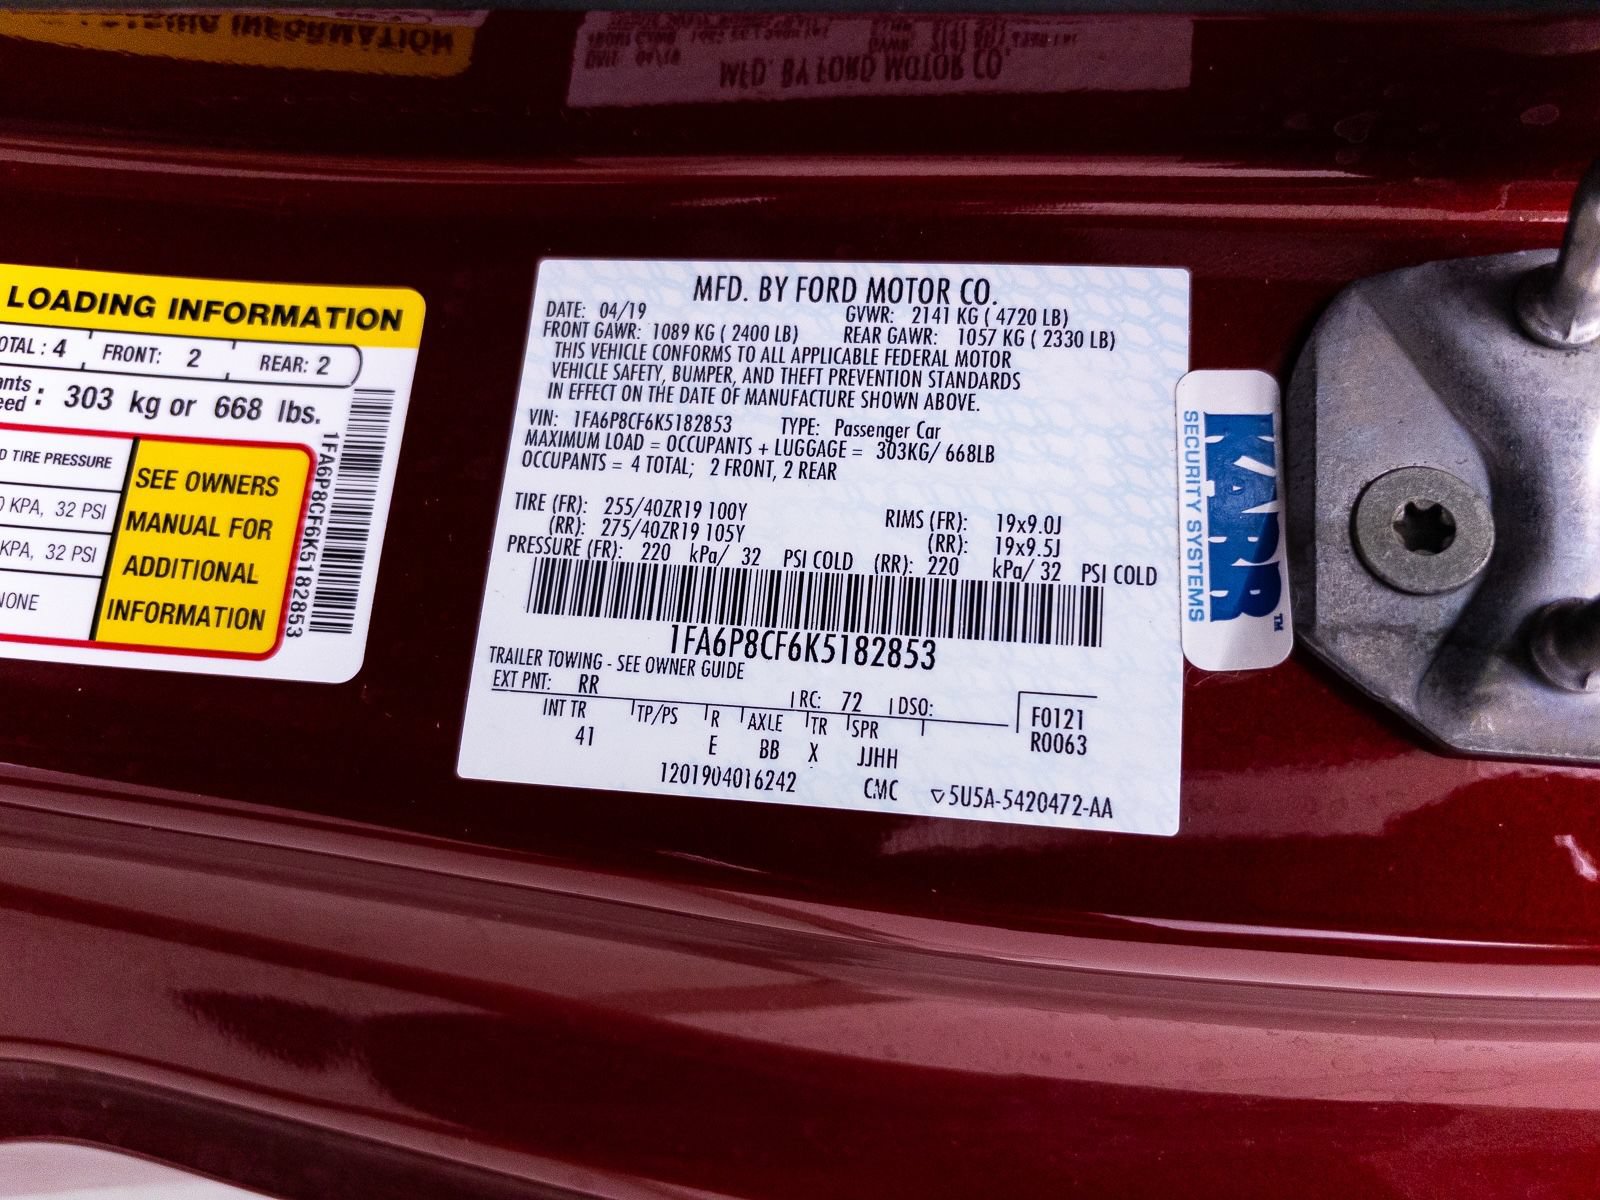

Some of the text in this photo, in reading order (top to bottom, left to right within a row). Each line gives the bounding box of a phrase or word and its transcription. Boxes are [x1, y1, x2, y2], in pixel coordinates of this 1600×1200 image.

[693, 275, 997, 305] MFD. BY FORD MOTOR CO.
[7, 285, 403, 331] LOADING INFORMATION
[546, 300, 647, 321] DATE: 04/19
[846, 305, 894, 323] GVWR:
[912, 306, 949, 324] 2141
[957, 307, 978, 325] KG
[996, 308, 1037, 326] 4720
[543, 320, 590, 338] FRONT
[594, 321, 641, 340] GAWR:
[654, 323, 690, 340] 1089
[695, 323, 715, 341] KG
[732, 324, 769, 342] 2400
[844, 326, 881, 344] REAR
[887, 327, 938, 345] GAWR:
[959, 328, 997, 346] 1057
[1003, 329, 1024, 347] KG
[1043, 329, 1084, 348] 2330
[53, 339, 67, 357] 4
[102, 344, 201, 368] FRONT: 2
[555, 341, 1011, 368] THIS VEHICLE CONFORMS TO ALL APPLICABLE FEDERAL MOTOR
[260, 354, 330, 375] REAR: 2
[552, 361, 1020, 390] VEHICLE SAFETY, BUMPER, AND THEFT PREVENTION STANDARDS
[64, 385, 320, 424] 303 kg or 668 lbs.
[548, 382, 980, 411] IN EFFECT ON THE DATE OF MANUFACTURE SHOWN ABOVE.
[530, 408, 732, 433] VIN: 1FA6P8CF6K5182853
[781, 417, 941, 446] TYPE: Passenger Car
[13, 449, 112, 469] TIRE PRESSURE
[524, 429, 600, 449] MAXIMUM
[605, 432, 644, 451] LOAD
[667, 434, 752, 455] OCCUPANTS
[775, 438, 847, 458] LUGGAGE
[946, 444, 995, 463] 668LB
[522, 450, 837, 482] OCCUPANTS 4 TOTAL; 2 FRONT, 2 REAR
[136, 467, 280, 497] SEE OWNERS
[9, 497, 43, 516] KPA,
[55, 501, 76, 518] 32
[81, 502, 107, 520] PSI
[515, 492, 747, 521] TIRE (FR): 255/40ZR19 100Y
[1183, 410, 1205, 623] SECURITY SYSTEMS
[1203, 411, 1282, 622] KARR
[125, 511, 273, 540] MANUAL FOR
[285, 431, 341, 638] 1FA6P8CF6K5182853
[549, 515, 745, 543] (RR): 275/40ZR19 105Y
[885, 509, 1061, 535] RIMS (FR): 19x9.0J
[0, 540, 97, 563] KPA, 32 PSI
[928, 533, 1060, 558] (RR): 19x9.5J
[122, 555, 258, 584] ADDITIONAL
[507, 535, 582, 556] PRESSURE
[585, 539, 623, 563] (FR):
[641, 542, 671, 561] 220
[741, 547, 761, 566] 32
[783, 549, 807, 568] PSI
[813, 550, 853, 571] COLD
[874, 553, 913, 576] (RR):
[927, 555, 959, 576] 220
[1040, 561, 1061, 581] 32
[1082, 563, 1106, 584] PSI
[1114, 564, 1157, 586] COLD
[107, 599, 266, 631] INFORMATION
[669, 624, 937, 671] 1FA6P8CF6K5182853
[490, 646, 745, 680] TRAILER TOWING SEE OWNER GUIDE
[493, 669, 599, 694] EXT PNT: RR
[543, 698, 587, 718] INT TR
[800, 690, 862, 712] RC: 72
[637, 704, 678, 725] TP/PS
[711, 710, 720, 728] R
[747, 713, 783, 732] AXLE
[811, 716, 827, 735] TR
[1032, 706, 1083, 730] F0121
[852, 720, 878, 739] SPR
[575, 726, 898, 769] 41 E BB X JJHH
[1031, 731, 1087, 755] R0063
[661, 762, 796, 792] 1201904016242
[864, 777, 898, 801] CMC
[949, 785, 1113, 819] 5U5A-5420472-AA
